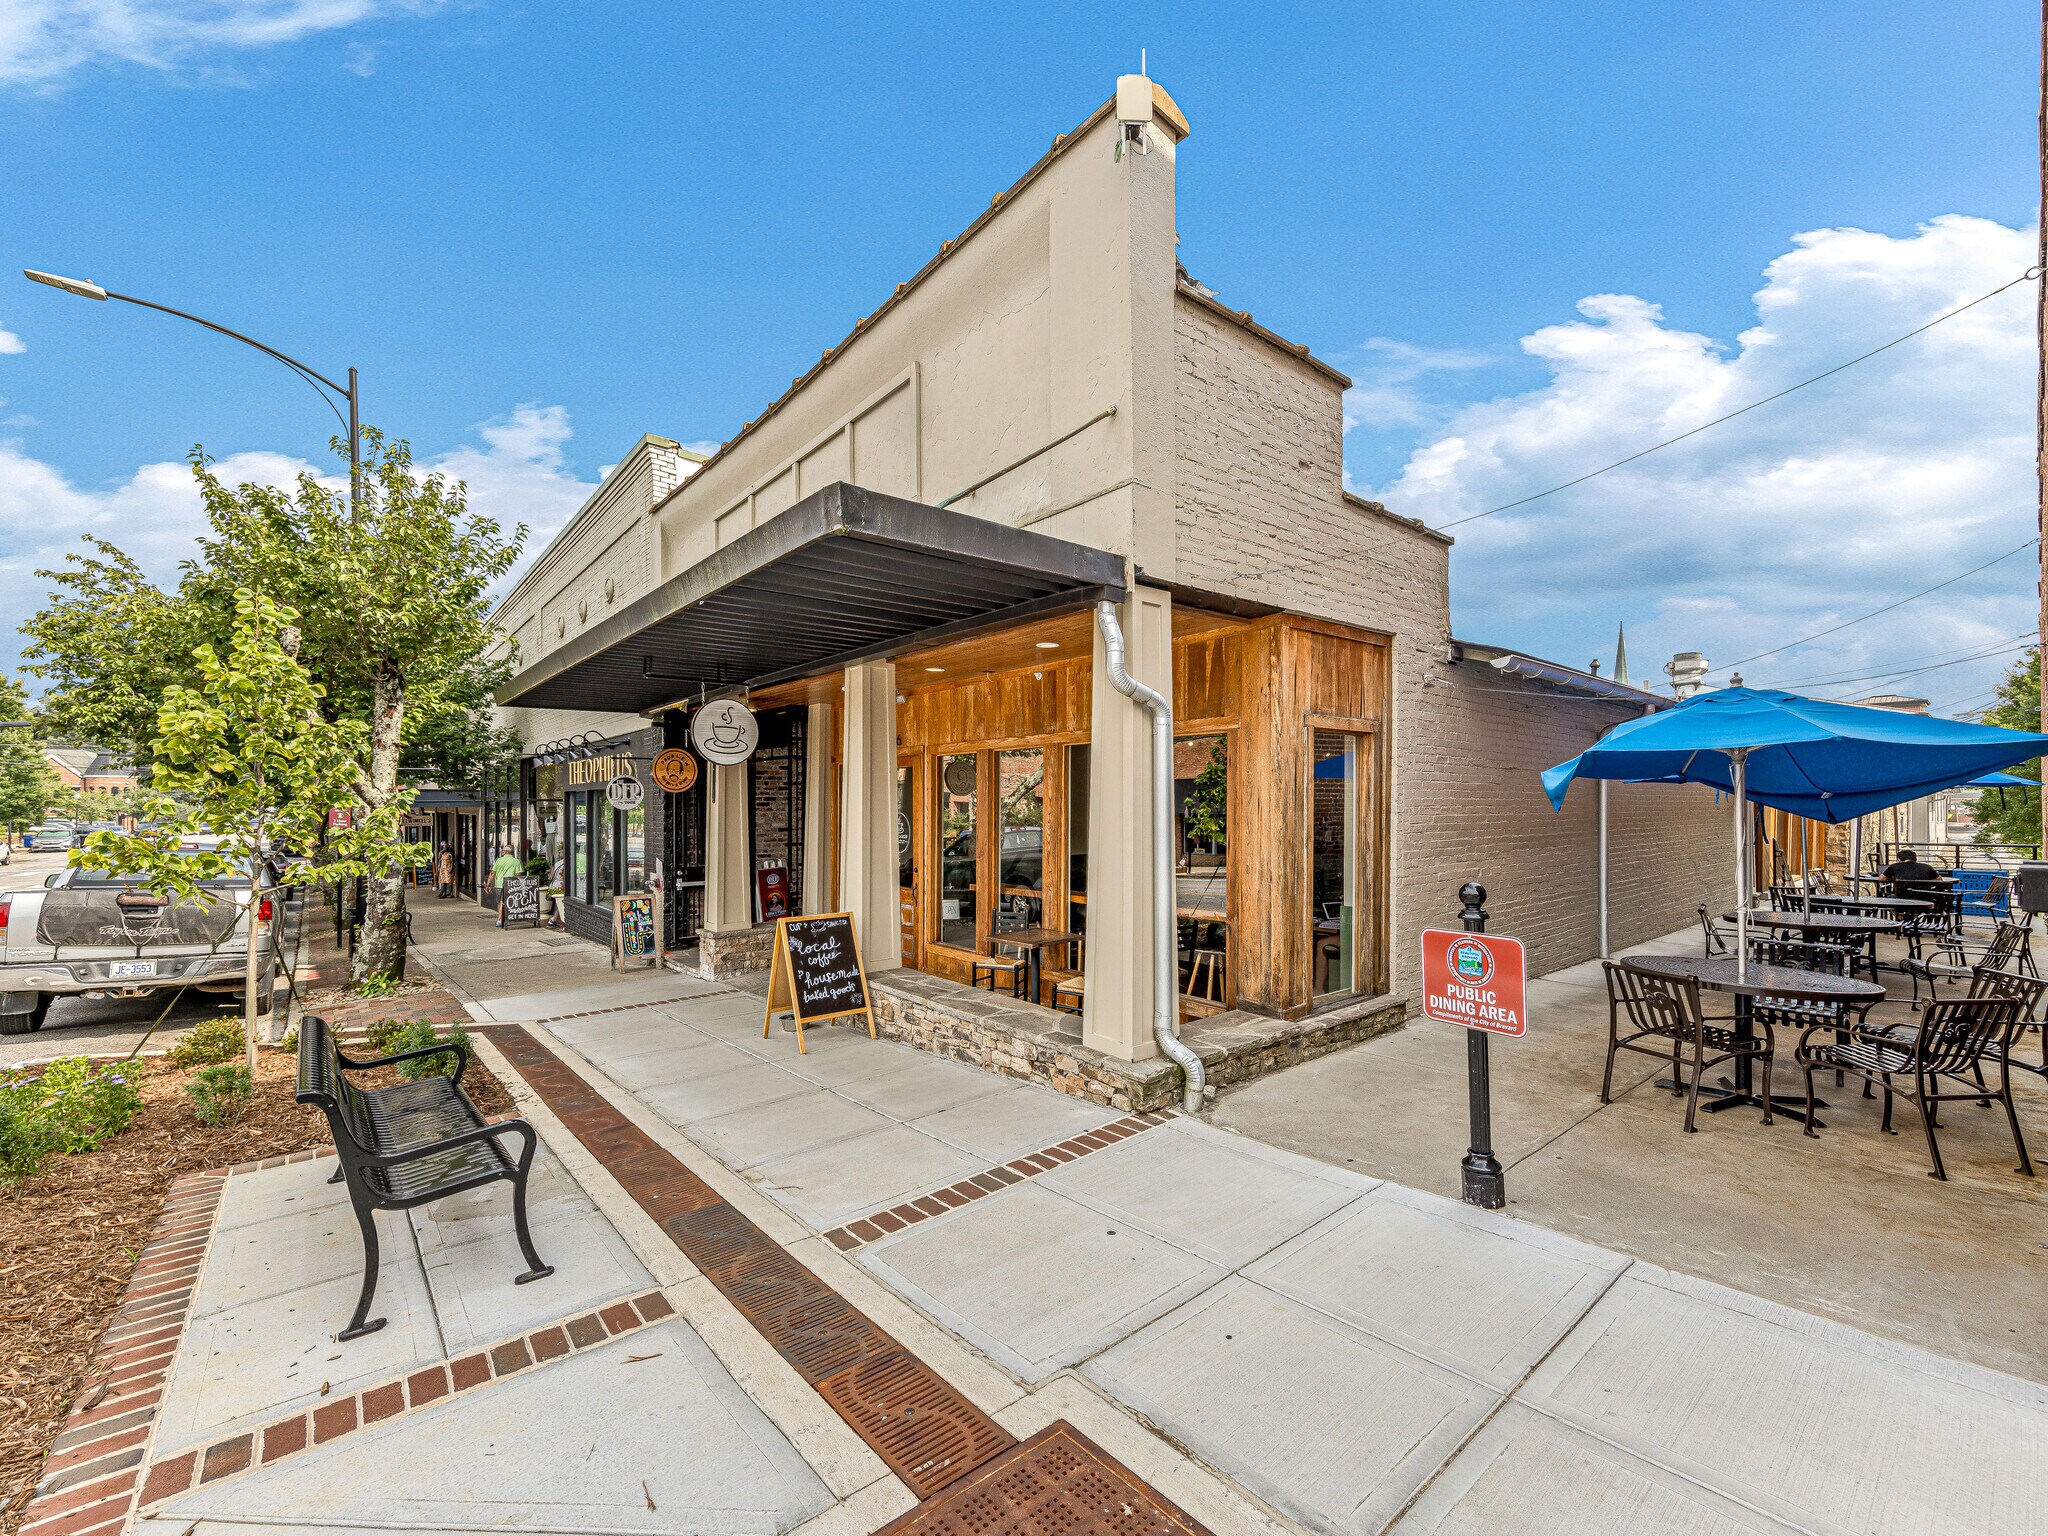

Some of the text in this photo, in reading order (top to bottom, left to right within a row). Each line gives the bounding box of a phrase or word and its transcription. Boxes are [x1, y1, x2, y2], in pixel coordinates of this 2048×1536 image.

[568, 751, 632, 785] THEOPHILUS
[506, 879, 538, 888] THEOHILUS
[506, 887, 539, 909] OPEN
[797, 936, 841, 955] local
[115, 964, 152, 975] JE-3553
[807, 951, 842, 968] coffee
[803, 981, 856, 1003] baked goods
[1447, 983, 1497, 1005] PUBLIC
[1429, 994, 1518, 1024] DINING AREA
[1432, 1009, 1463, 1019] Compliments
[1479, 1018, 1489, 1027] City
[1496, 1022, 1517, 1031] Brevard
